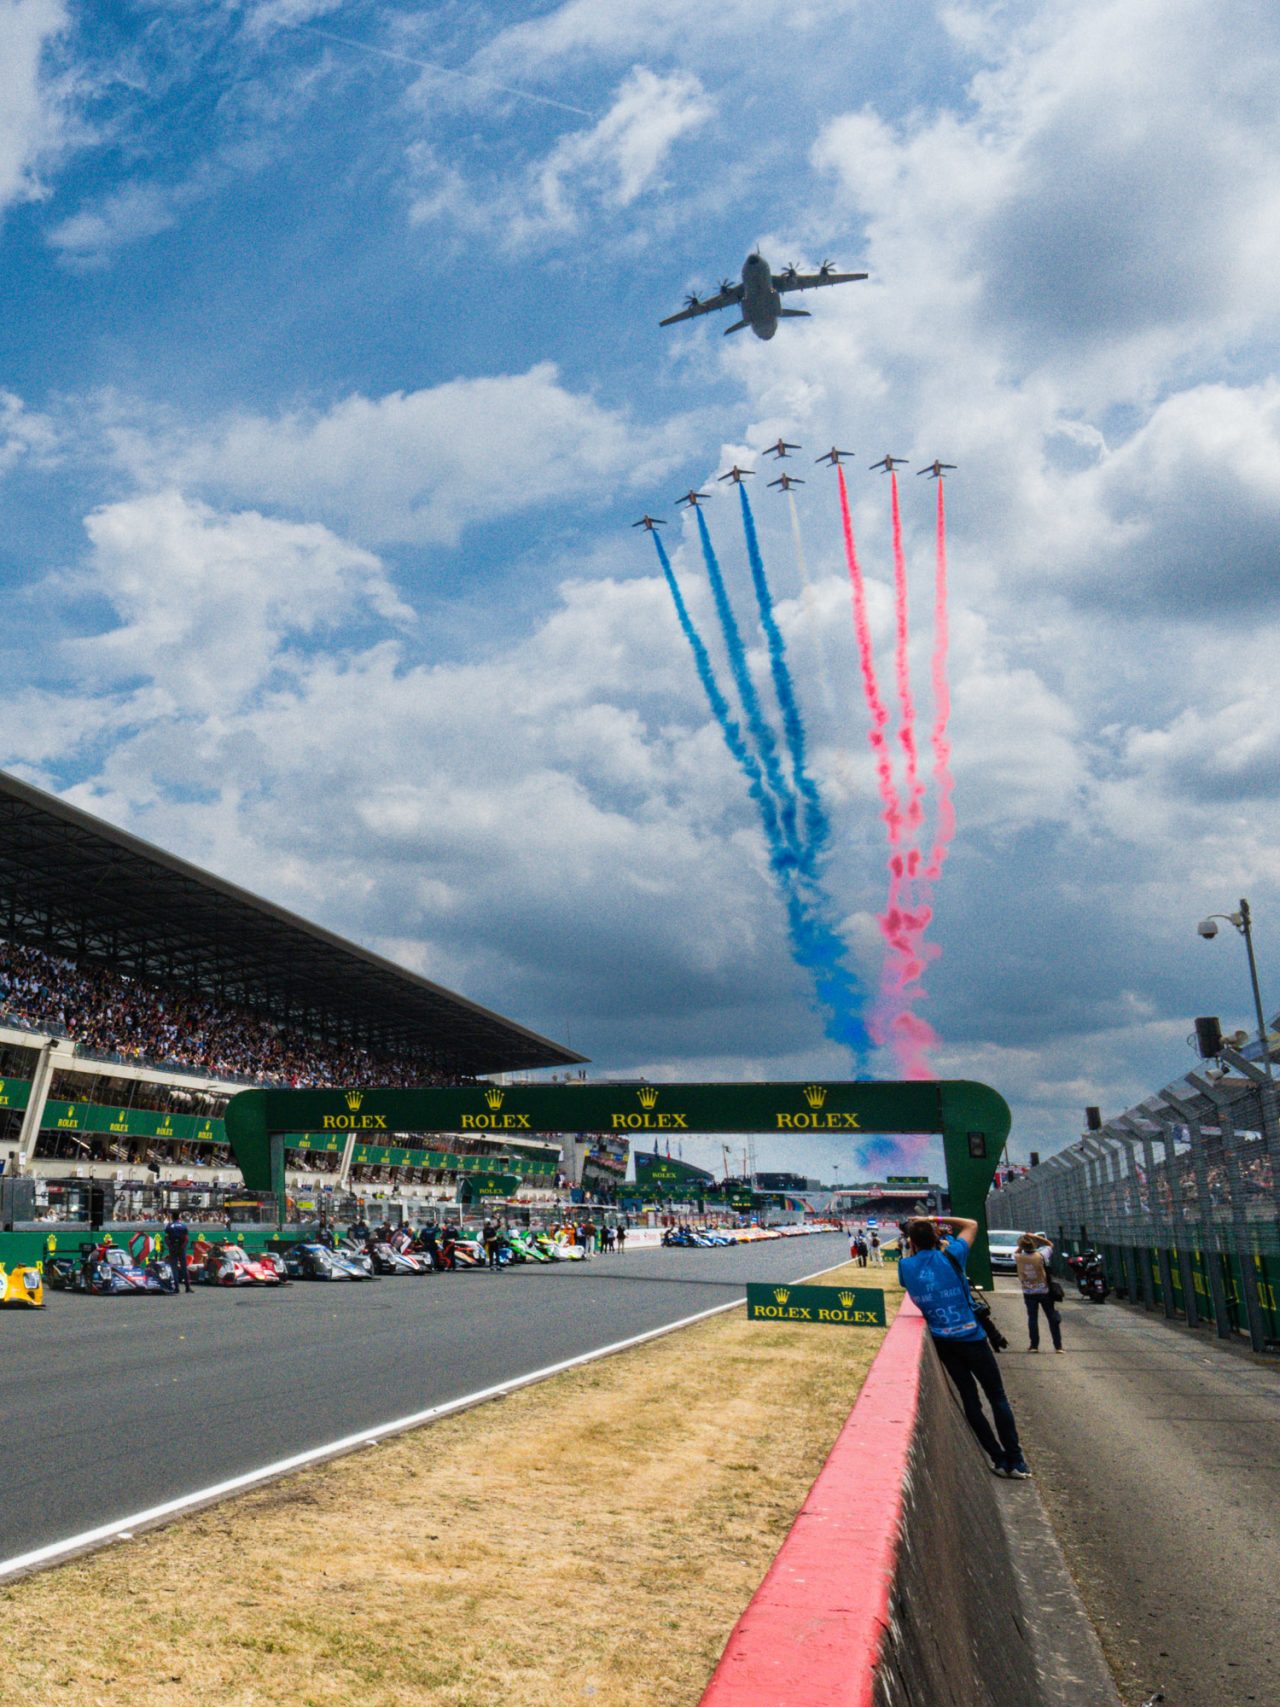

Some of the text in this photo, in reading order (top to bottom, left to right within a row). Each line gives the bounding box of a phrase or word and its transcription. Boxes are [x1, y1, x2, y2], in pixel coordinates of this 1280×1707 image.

[57, 1119, 78, 1128] ROLEX
[323, 1115, 387, 1129] ROLEX
[461, 1114, 531, 1128] ROLEX
[611, 1113, 688, 1128] ROLEX
[776, 1113, 860, 1128] ROLEX
[754, 1305, 878, 1324] ROLEX ROLEX
